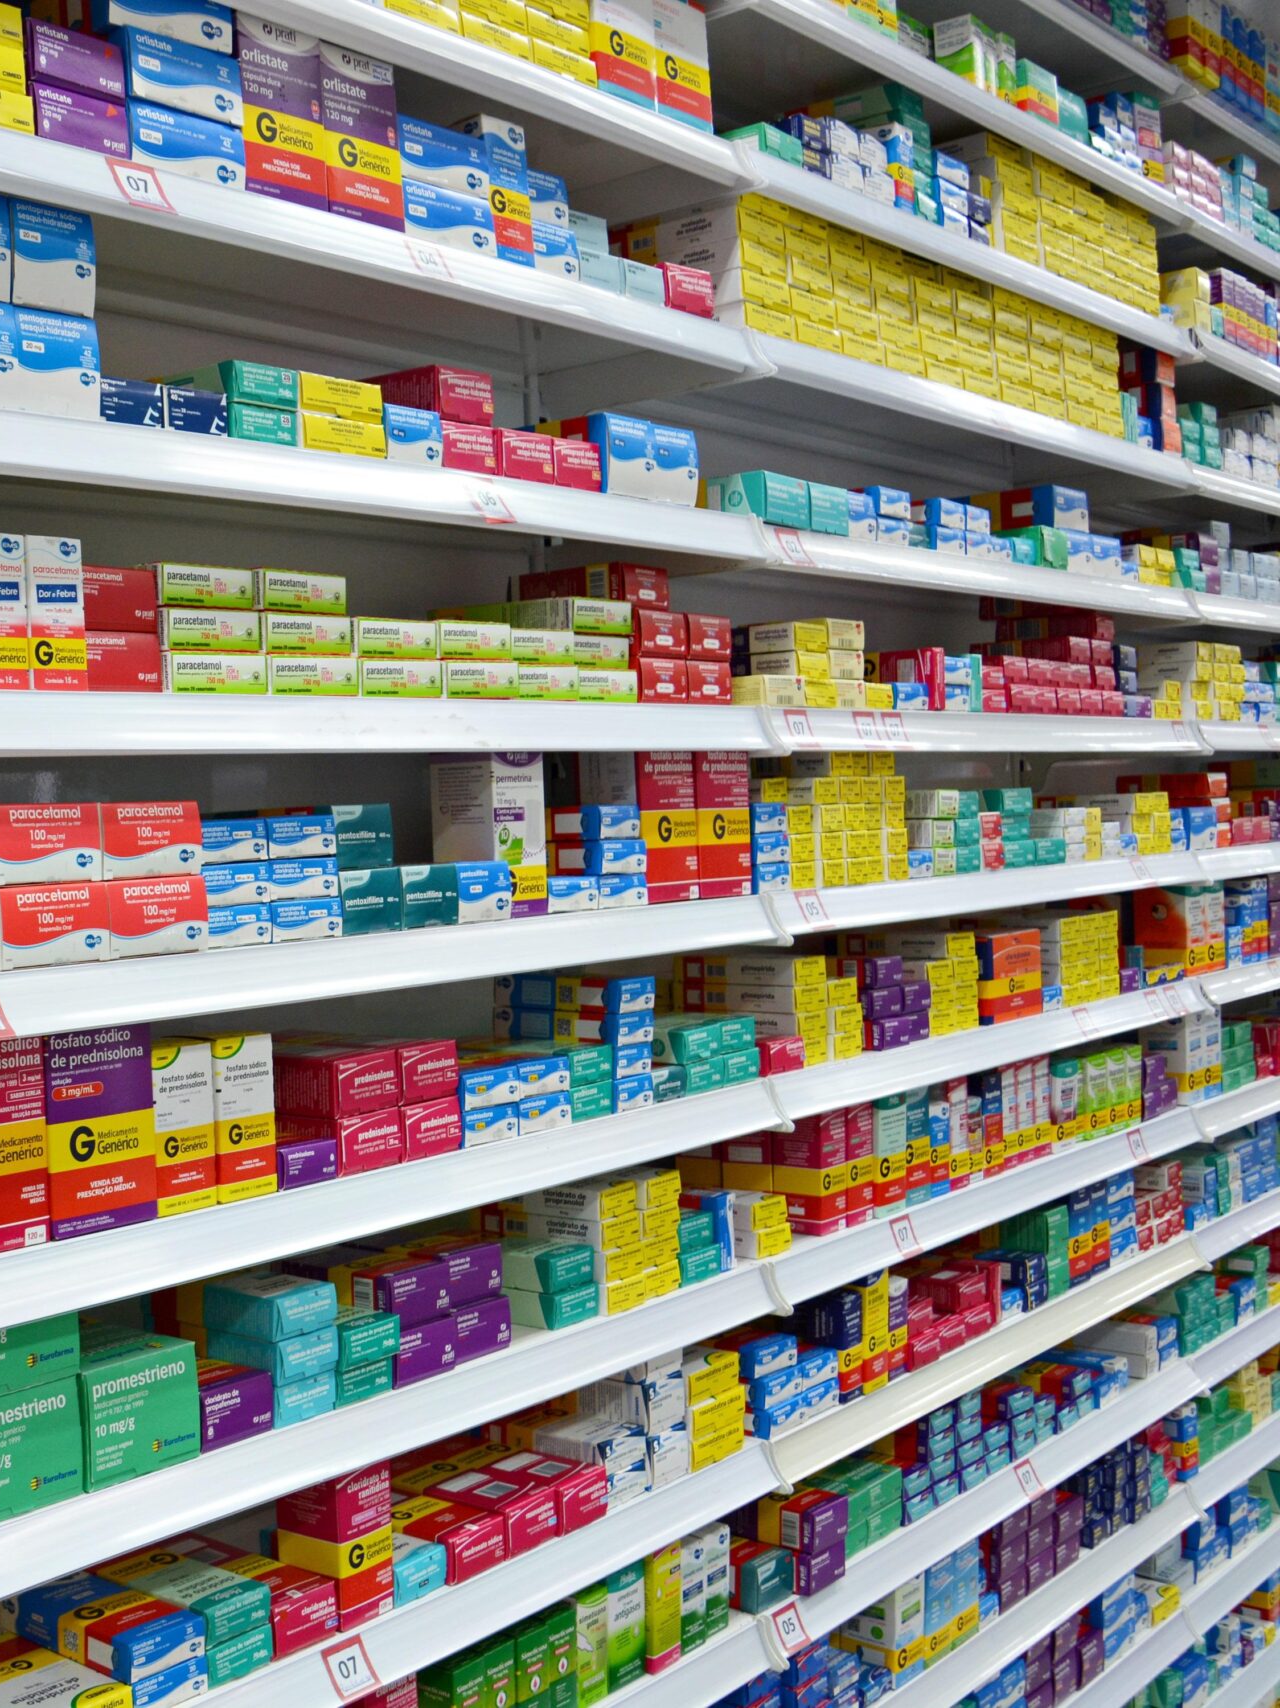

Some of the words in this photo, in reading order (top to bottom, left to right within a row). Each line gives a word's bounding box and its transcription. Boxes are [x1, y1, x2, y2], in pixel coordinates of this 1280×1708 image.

[136, 32, 172, 53] orlistate
[241, 48, 288, 71] orlistate
[279, 134, 314, 152] Genérico
[126, 175, 148, 194] 07
[167, 572, 210, 583] paracetamol
[496, 773, 532, 784] permetrina
[9, 806, 81, 821] paracetamol
[29, 830, 45, 841] 100
[47, 831, 71, 842] mg/ml
[17, 886, 90, 907] paracetamol
[50, 1032, 95, 1049] fosfato
[98, 1029, 131, 1044] sódico
[51, 1054, 68, 1067] de
[72, 1044, 143, 1067] prednisolona
[92, 1361, 186, 1402] promestrieno
[782, 1616, 797, 1635] 05
[338, 1656, 359, 1677] 07
